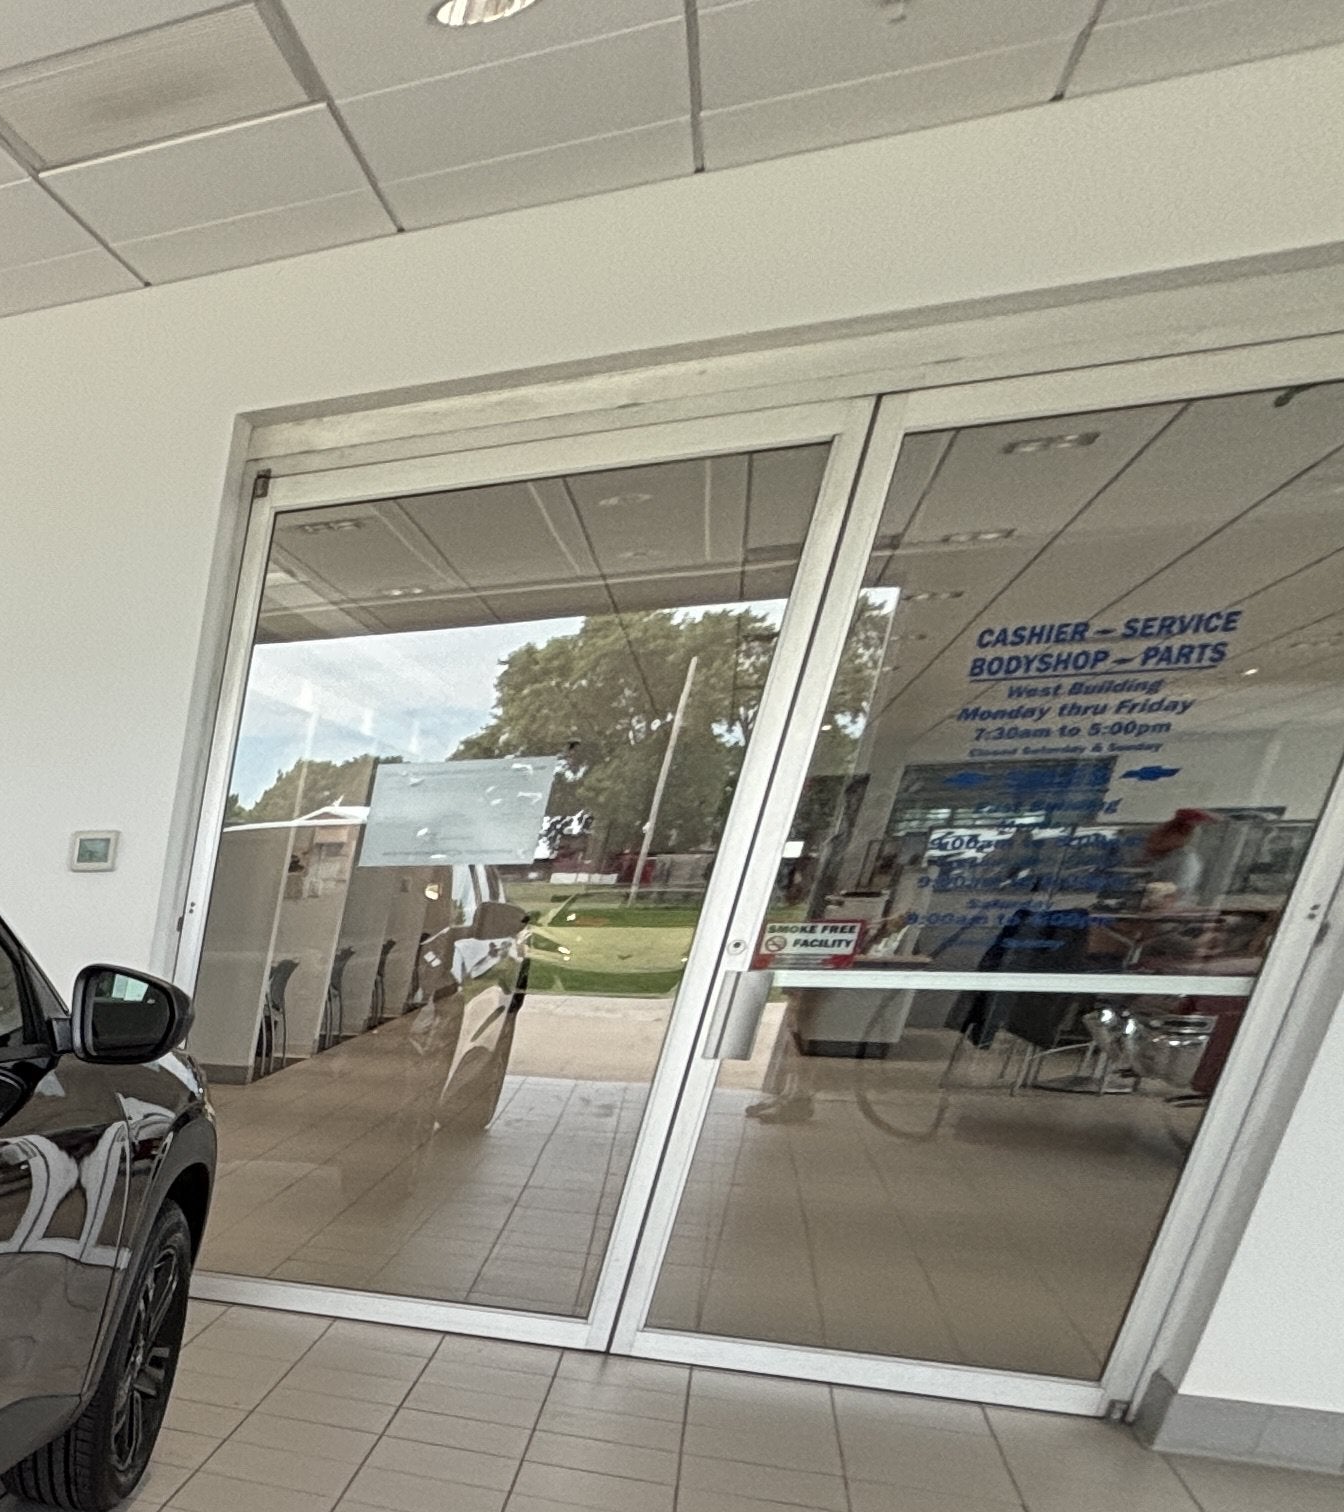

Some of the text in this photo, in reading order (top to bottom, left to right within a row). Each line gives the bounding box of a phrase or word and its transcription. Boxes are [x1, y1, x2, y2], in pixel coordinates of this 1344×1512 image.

[976, 621, 1090, 649] CASHIER
[1121, 610, 1243, 639] SERVICE
[968, 649, 1110, 677] BODYSHOP
[1139, 641, 1229, 667] PARTS
[1007, 678, 1165, 699] West Building
[956, 699, 1197, 722] Monday thru Friday
[1059, 723, 1082, 738] to
[1087, 720, 1173, 738] 5:00pm
[767, 924, 857, 934] SMOKE FREE
[792, 938, 854, 948] FACILITY
